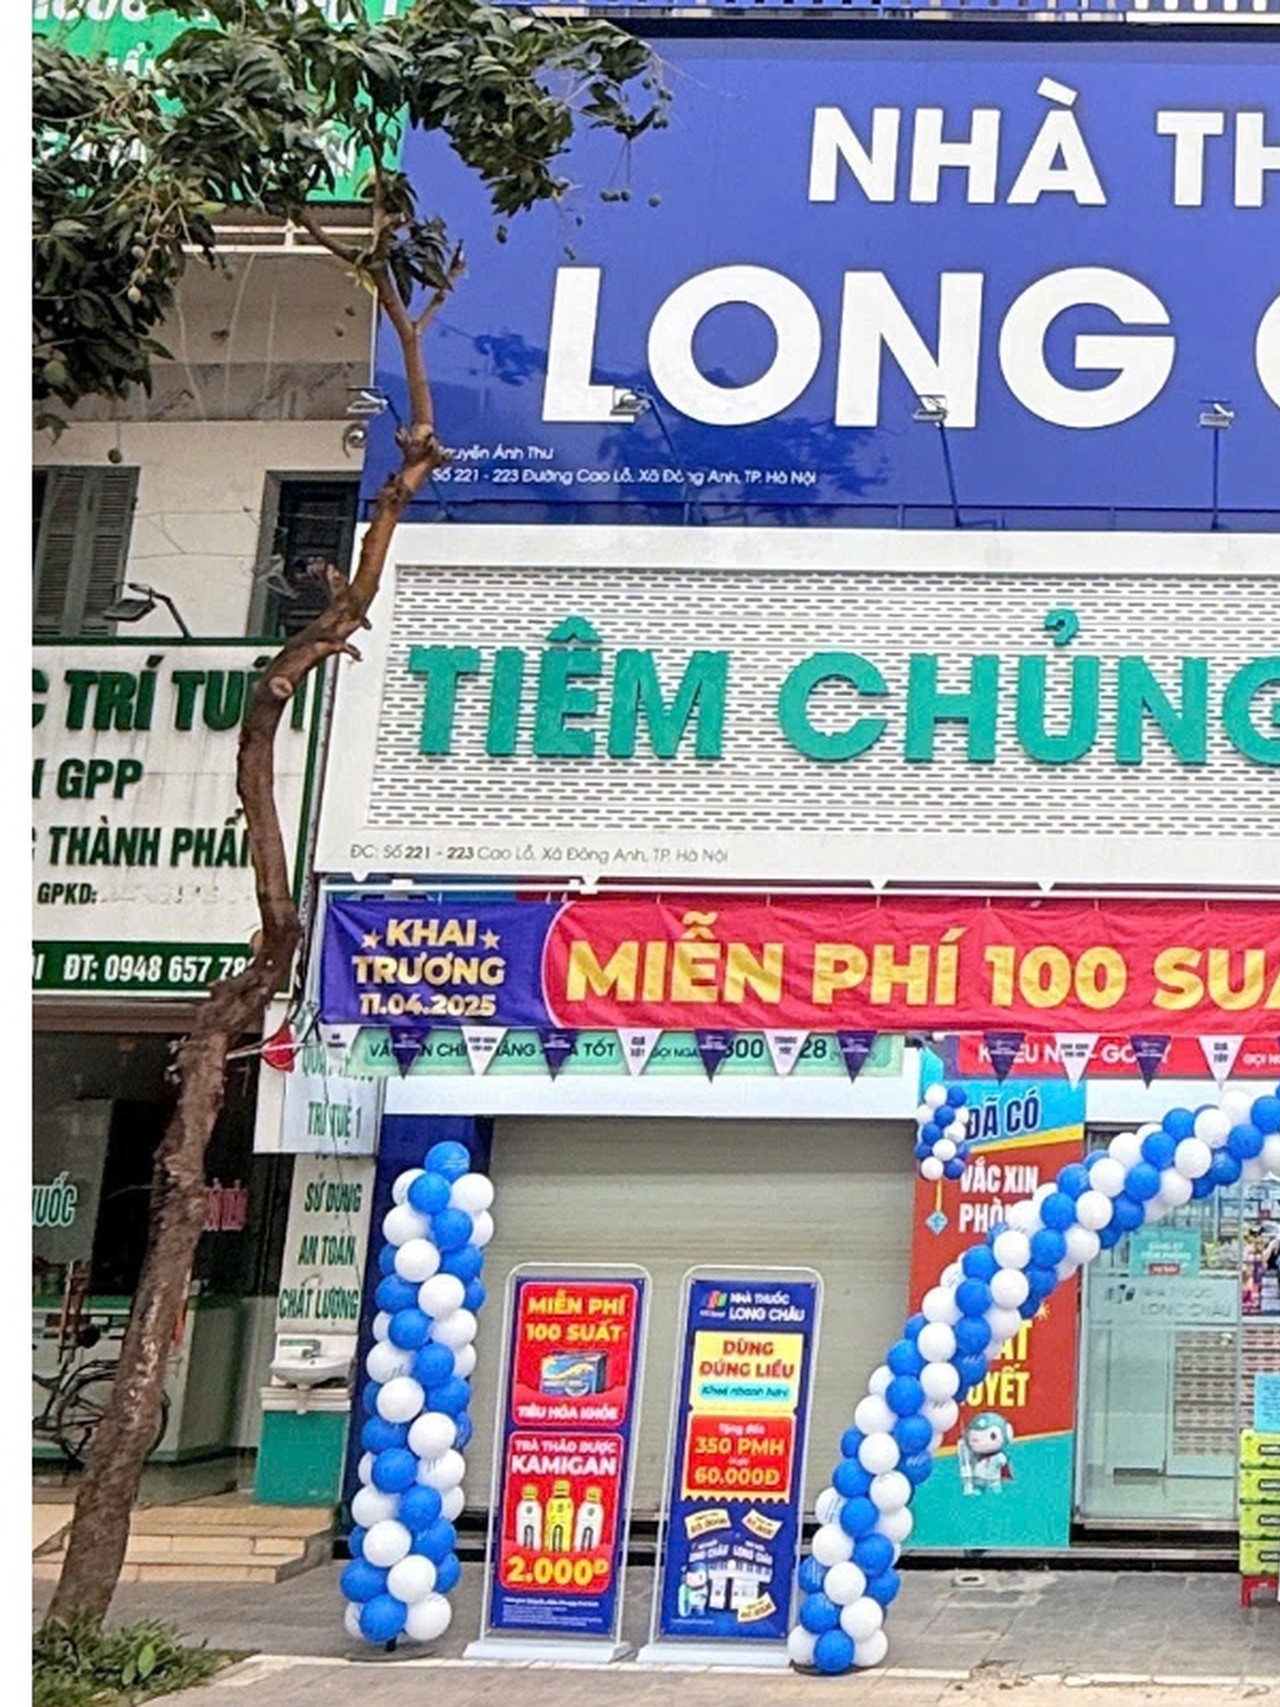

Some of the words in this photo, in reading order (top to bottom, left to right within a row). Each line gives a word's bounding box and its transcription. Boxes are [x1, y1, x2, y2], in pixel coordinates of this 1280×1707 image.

[808, 76, 1107, 207] NHÀ
[540, 262, 1176, 432] LONG
[454, 469, 479, 483] 221
[492, 468, 519, 483] 223
[576, 468, 611, 483] Cao
[64, 655, 164, 731] TRÍ
[408, 616, 732, 761] TIÊM
[56, 758, 143, 800] GPP
[49, 815, 161, 867] THÀNH
[405, 846, 430, 860] 221
[447, 847, 474, 860] 223
[477, 847, 511, 861] Cao
[37, 882, 97, 905] GPKD:
[386, 918, 478, 948] KHAI
[63, 953, 98, 982] ĐT:
[104, 954, 162, 983] 0948
[168, 955, 211, 983] 657
[351, 953, 506, 986] TRƯƠNG
[565, 910, 784, 1004] MIỄN
[813, 926, 967, 1006] PHÍ
[984, 944, 1128, 1009] 100
[359, 992, 497, 1018] 11.04.2025
[1006, 1088, 1040, 1133] CÓ
[961, 1155, 1001, 1194] VẮC
[1003, 1166, 1040, 1194] XIN
[298, 1235, 319, 1266] AN
[528, 1289, 583, 1316] MIỄN
[588, 1294, 629, 1316] PHÍ
[730, 1291, 751, 1305] NHÀ
[754, 1290, 790, 1306] THUỐC
[729, 1307, 767, 1321] LONG
[769, 1305, 805, 1322] CHÂU
[525, 1323, 562, 1342] 100
[566, 1319, 624, 1343] SUẤT
[695, 1438, 731, 1455] 350
[737, 1439, 785, 1456] PMH
[511, 1455, 617, 1476] KAMIGAN
[694, 1467, 780, 1486] 60.000Đ
